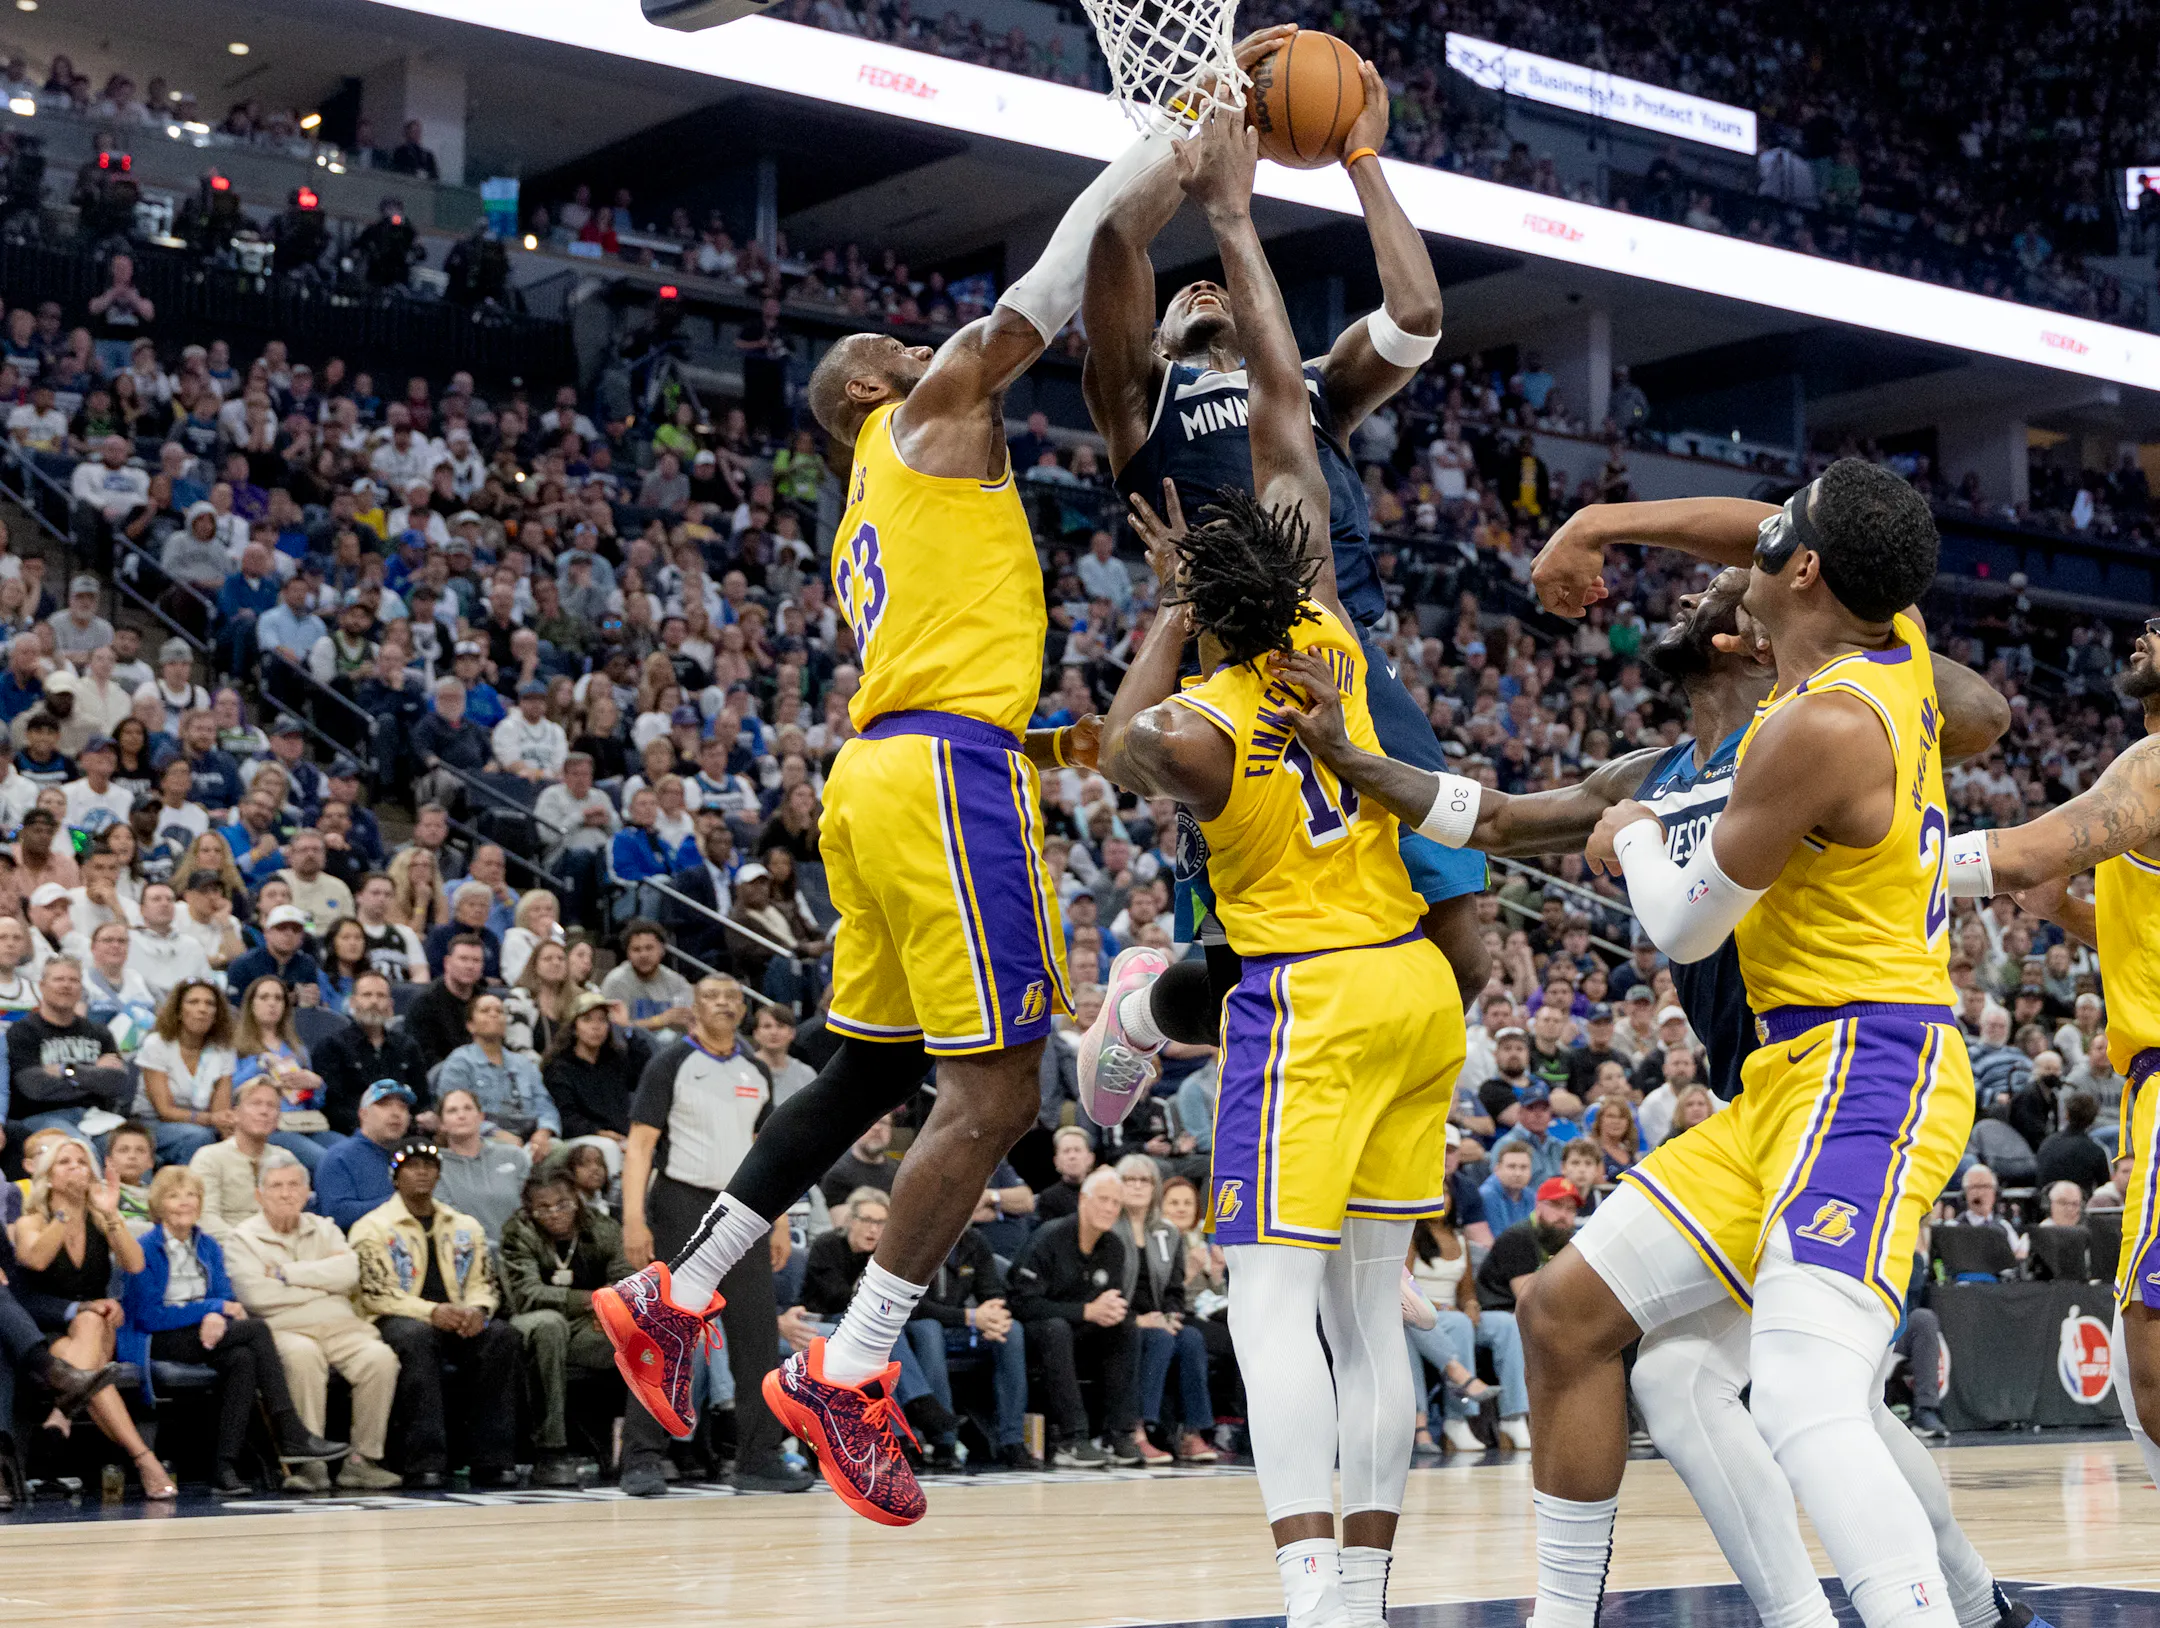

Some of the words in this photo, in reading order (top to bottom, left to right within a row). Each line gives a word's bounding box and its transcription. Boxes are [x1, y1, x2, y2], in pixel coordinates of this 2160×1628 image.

[1632, 93, 1694, 125] Protect
[837, 519, 889, 664] 23
[1450, 788, 1469, 813] 30
[1179, 815, 1206, 870] TIMBERWOLVES
